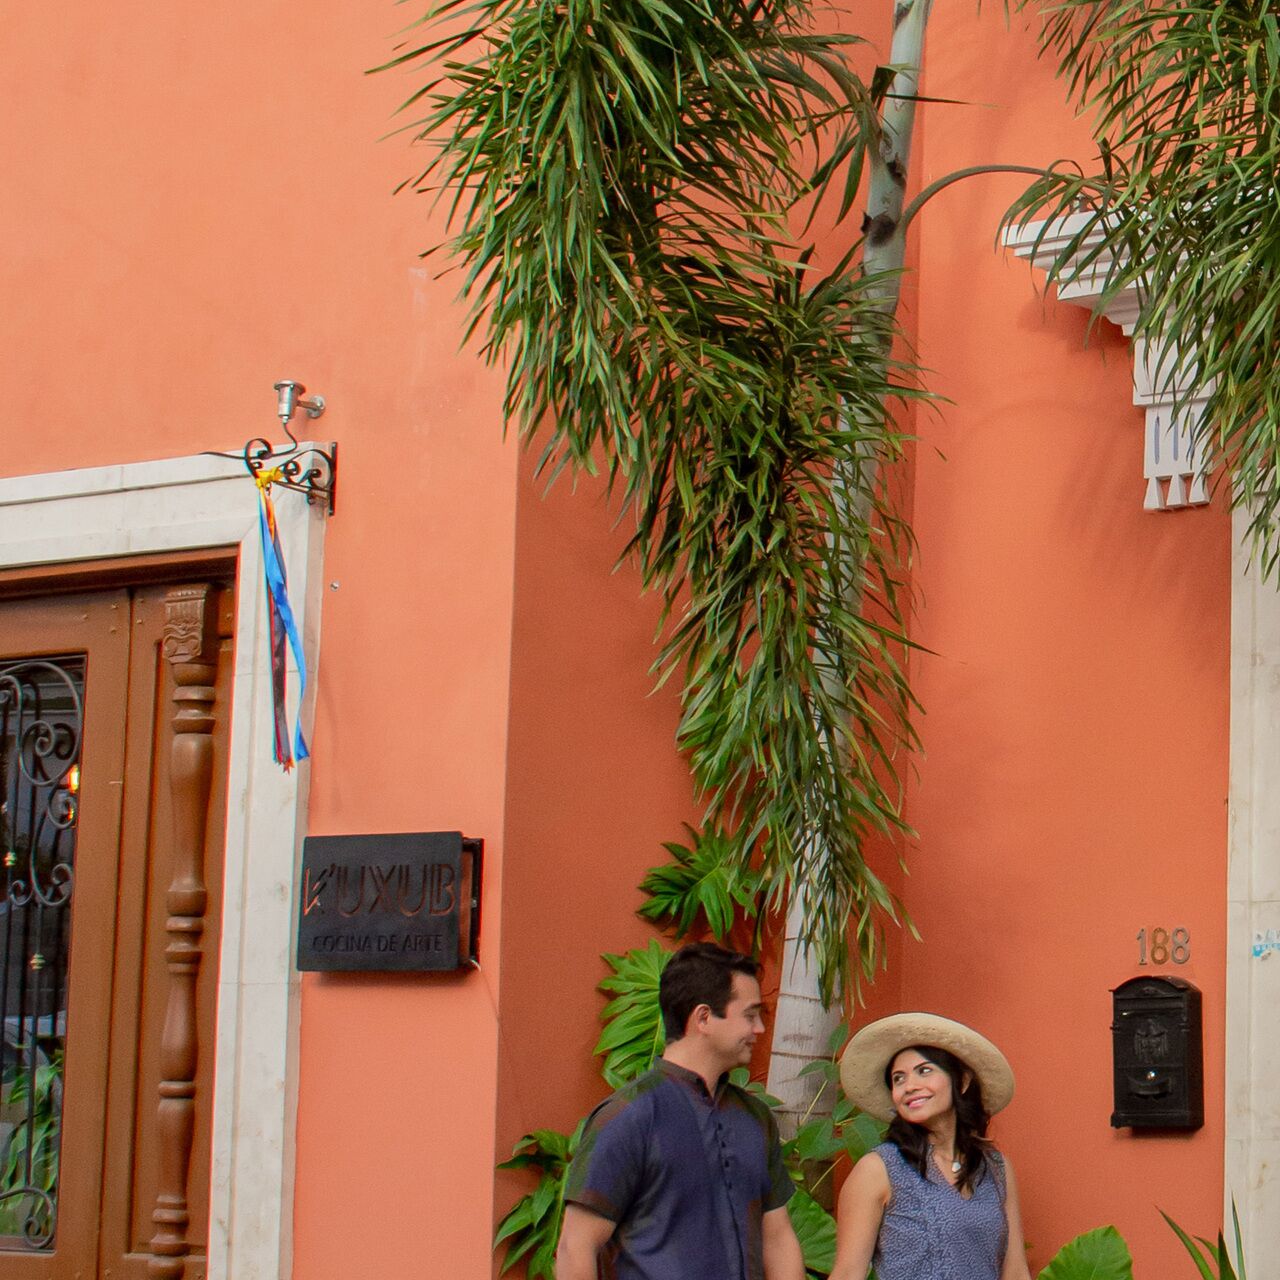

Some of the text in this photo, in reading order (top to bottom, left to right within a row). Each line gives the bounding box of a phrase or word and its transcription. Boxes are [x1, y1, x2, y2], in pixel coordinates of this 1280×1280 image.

[313, 934, 443, 953] COCINA DE ARTE
[1136, 927, 1190, 965] 188
